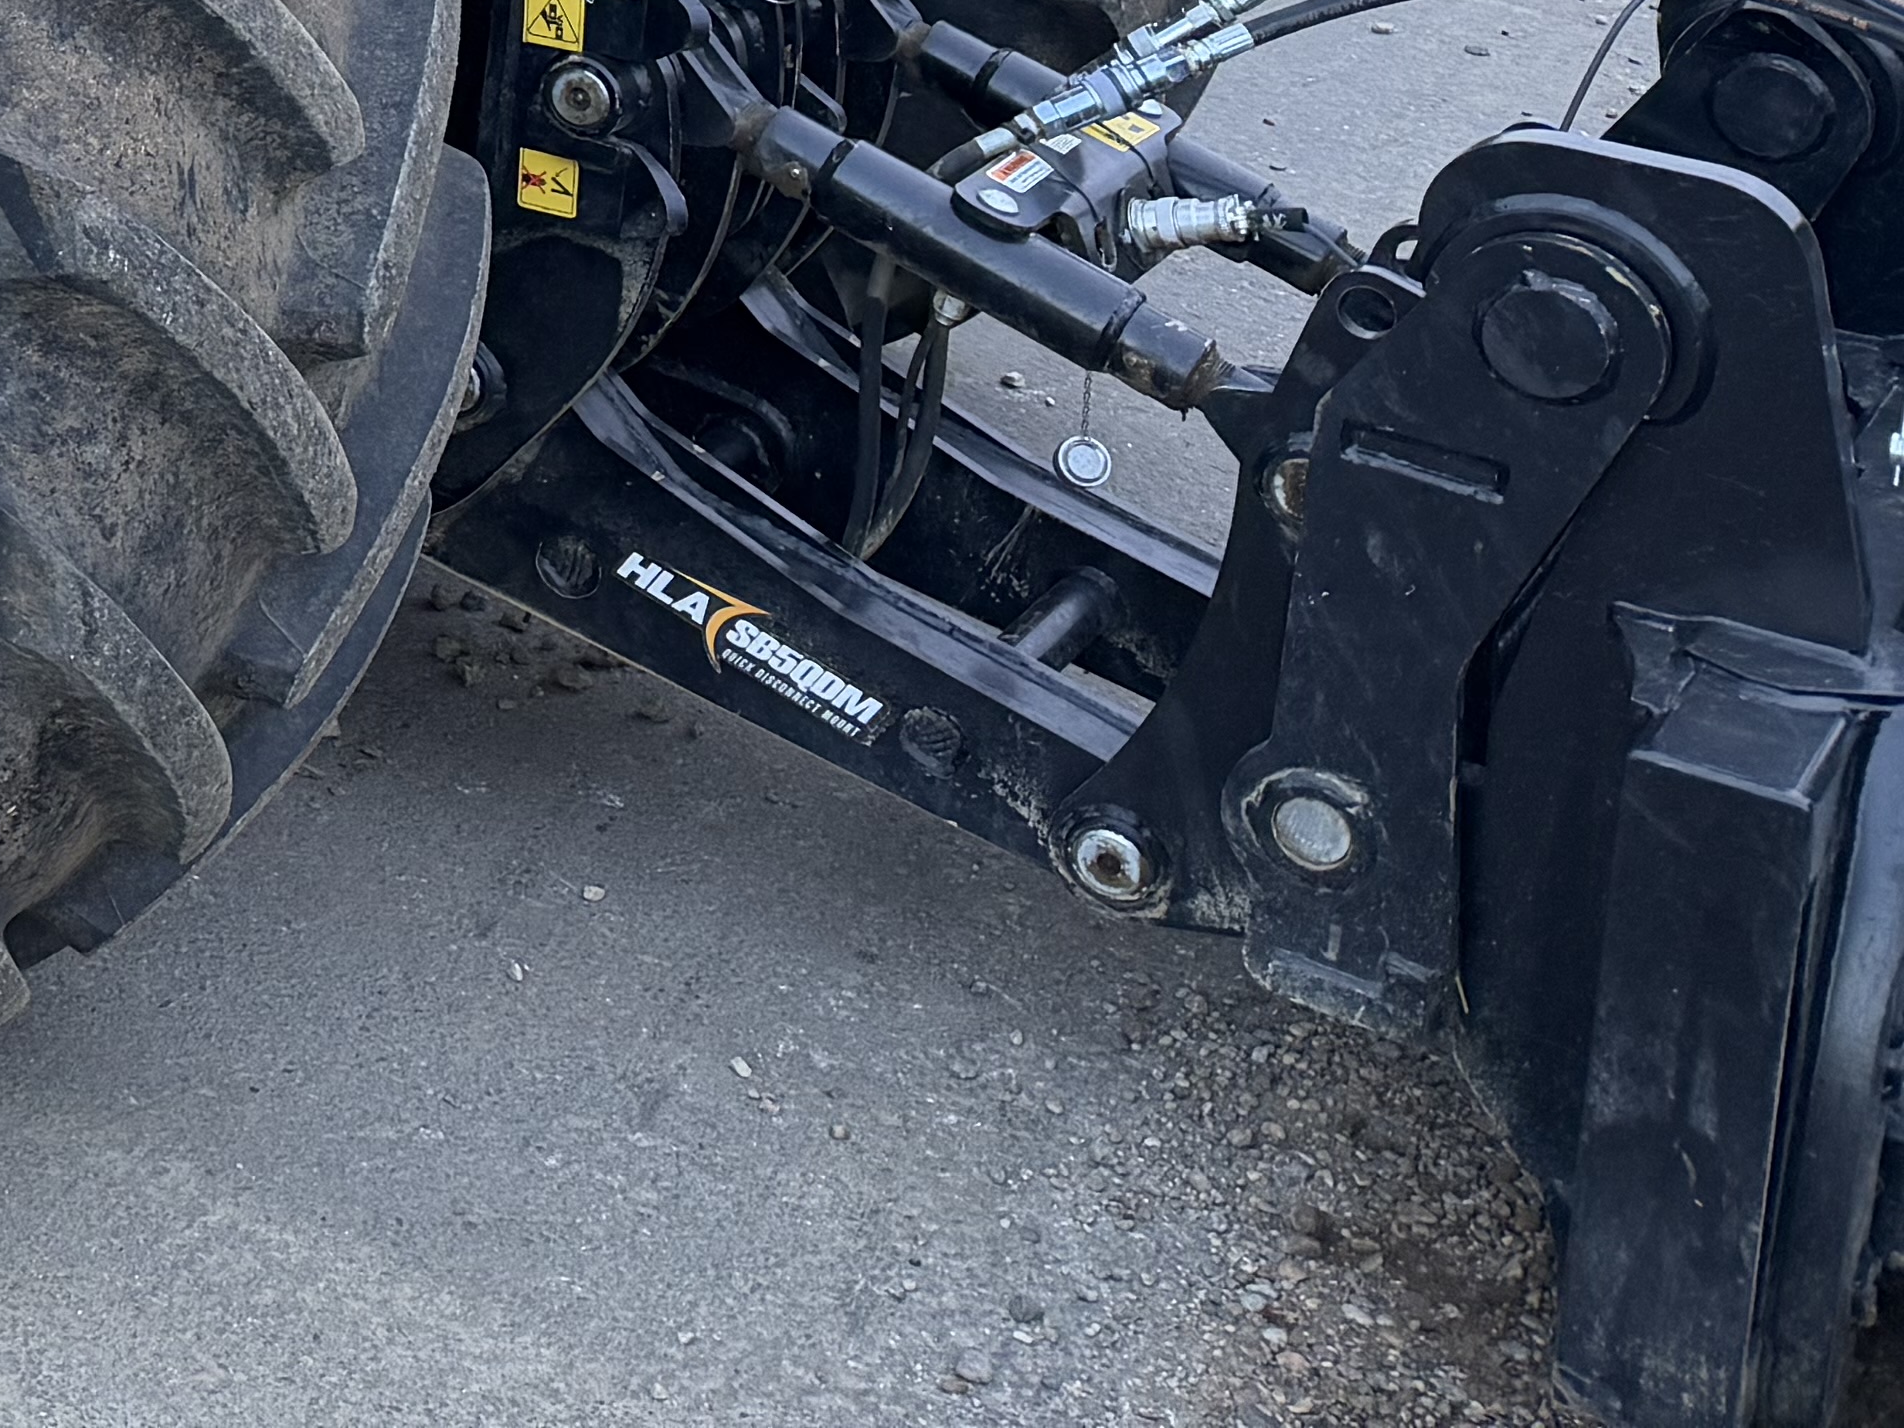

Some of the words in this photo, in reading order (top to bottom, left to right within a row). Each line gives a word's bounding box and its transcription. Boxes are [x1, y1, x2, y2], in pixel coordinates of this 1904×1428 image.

[616, 551, 710, 625] HLA
[725, 619, 884, 725] SB5QDM
[721, 648, 757, 672] QUICK
[754, 668, 822, 714] DISCONNECT
[821, 709, 861, 738] MOUNT
